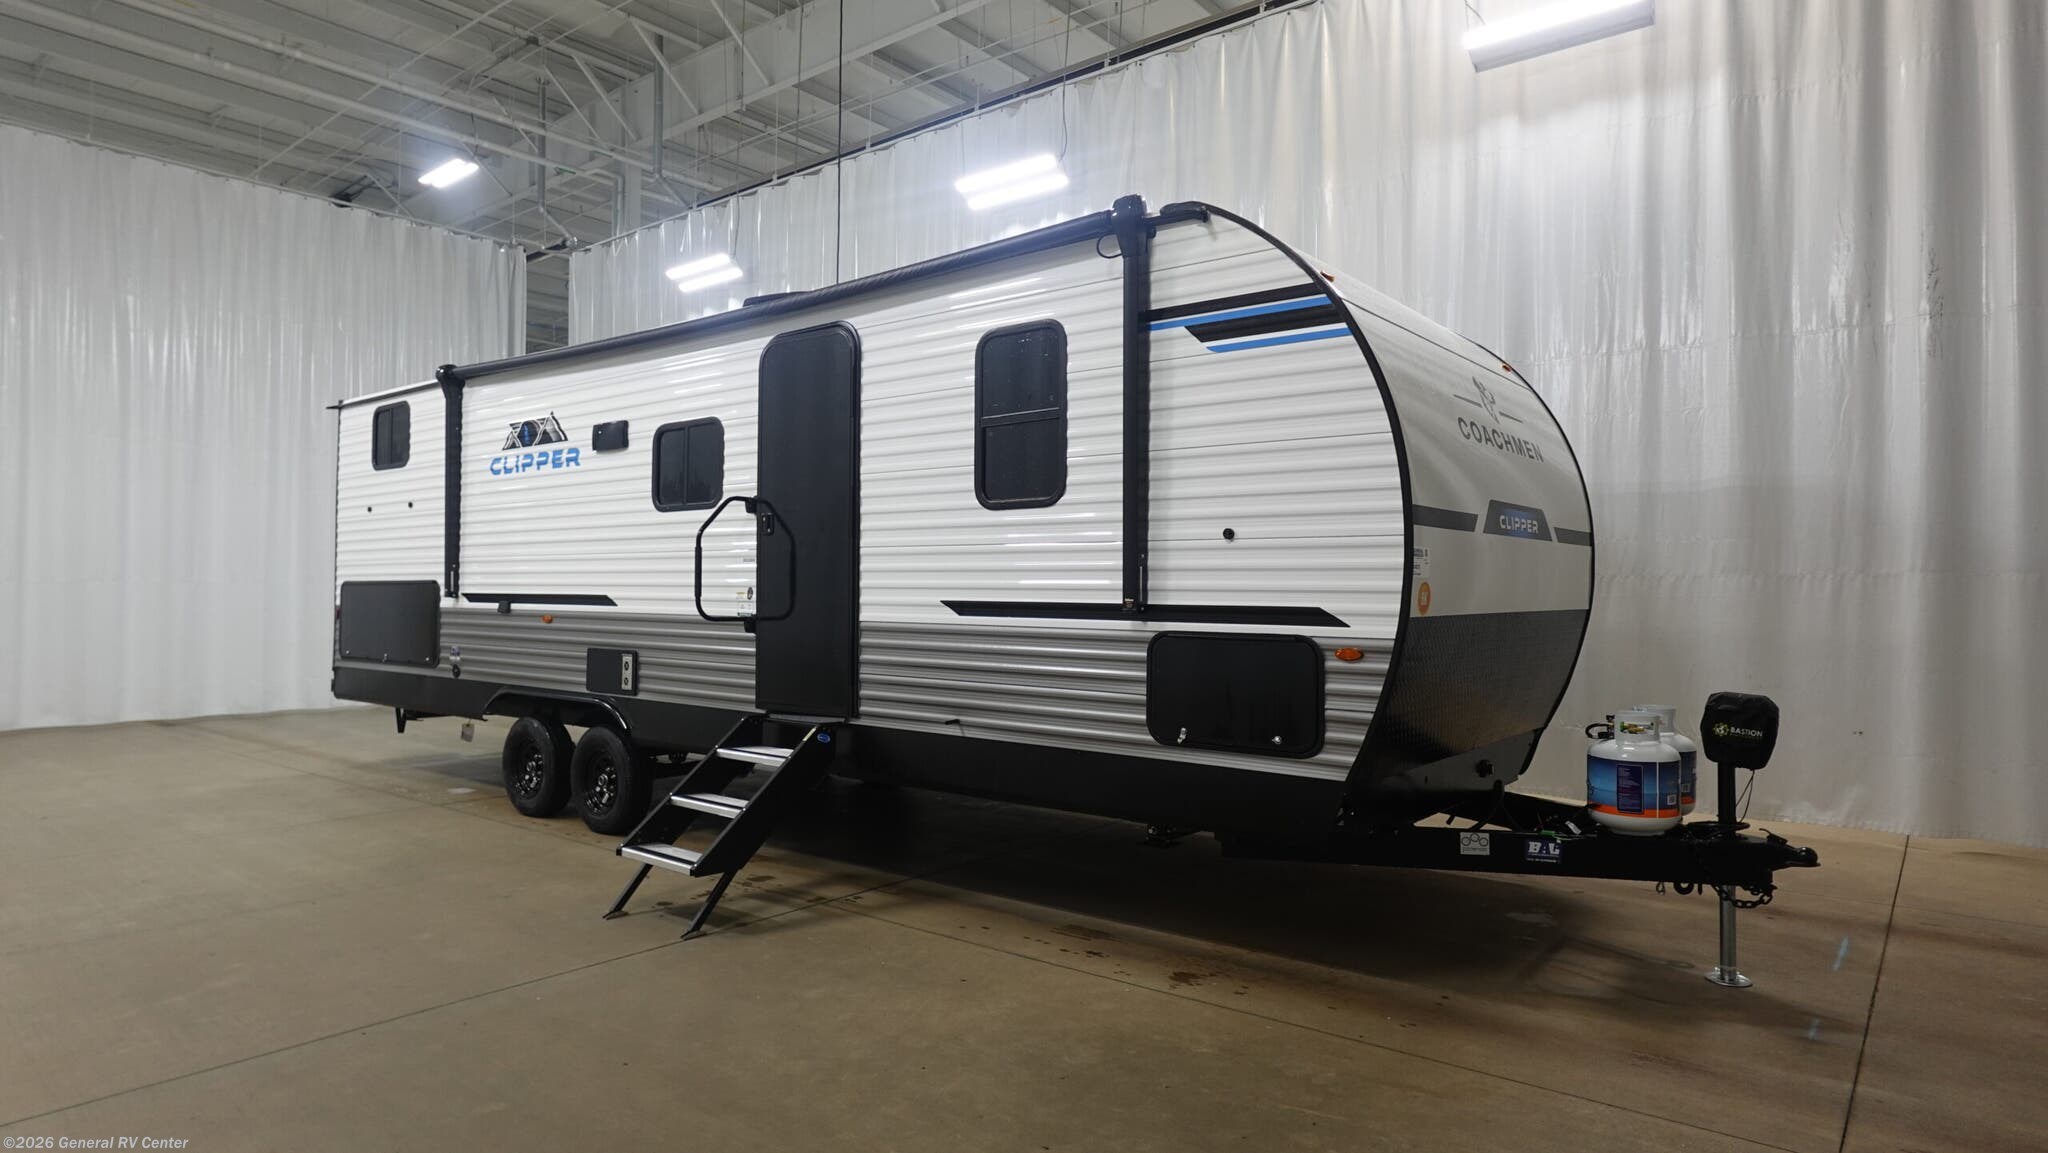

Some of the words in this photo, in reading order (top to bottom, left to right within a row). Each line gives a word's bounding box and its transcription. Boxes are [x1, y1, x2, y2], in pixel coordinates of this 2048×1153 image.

[1457, 416, 1545, 463] COACHMEN
[489, 447, 581, 476] CLIPPER
[1499, 514, 1539, 534] CLIPPER
[1730, 726, 1763, 737] BASTION
